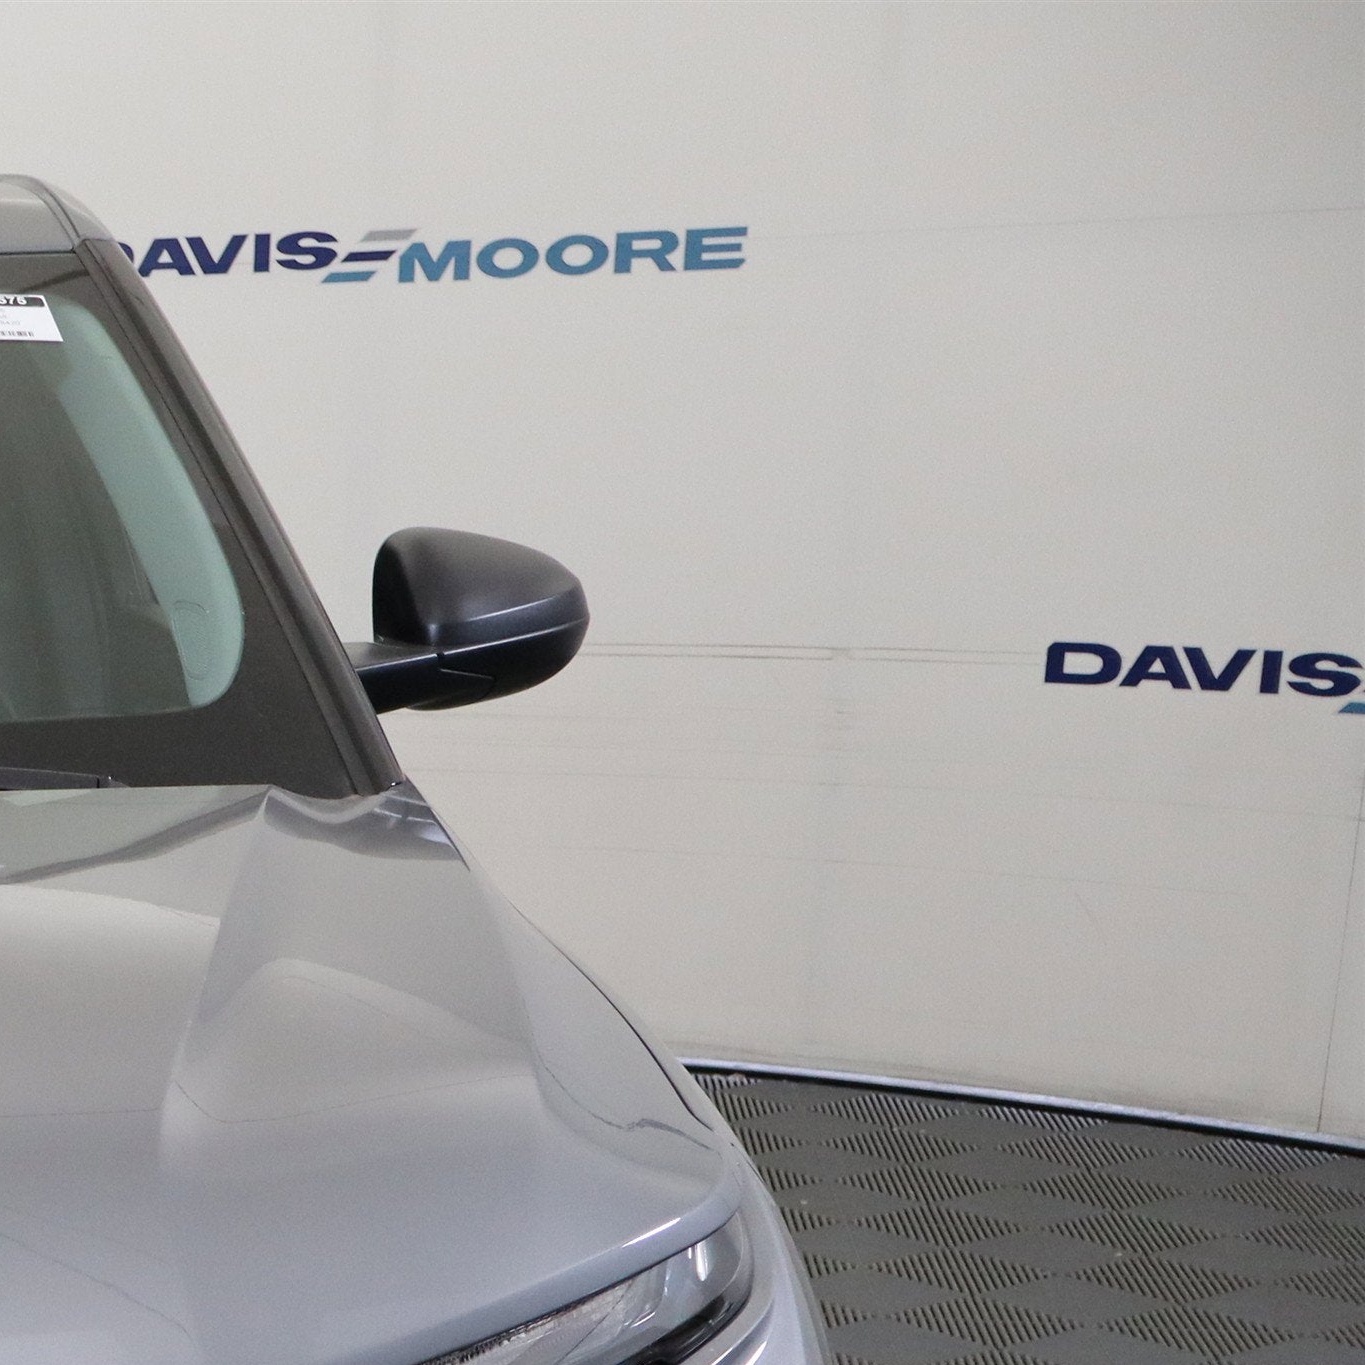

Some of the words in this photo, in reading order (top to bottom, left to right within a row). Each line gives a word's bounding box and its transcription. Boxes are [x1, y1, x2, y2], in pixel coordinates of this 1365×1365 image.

[117, 231, 338, 277] AVIS
[396, 226, 748, 284] MOORE
[1044, 641, 1363, 698] DAVIS
